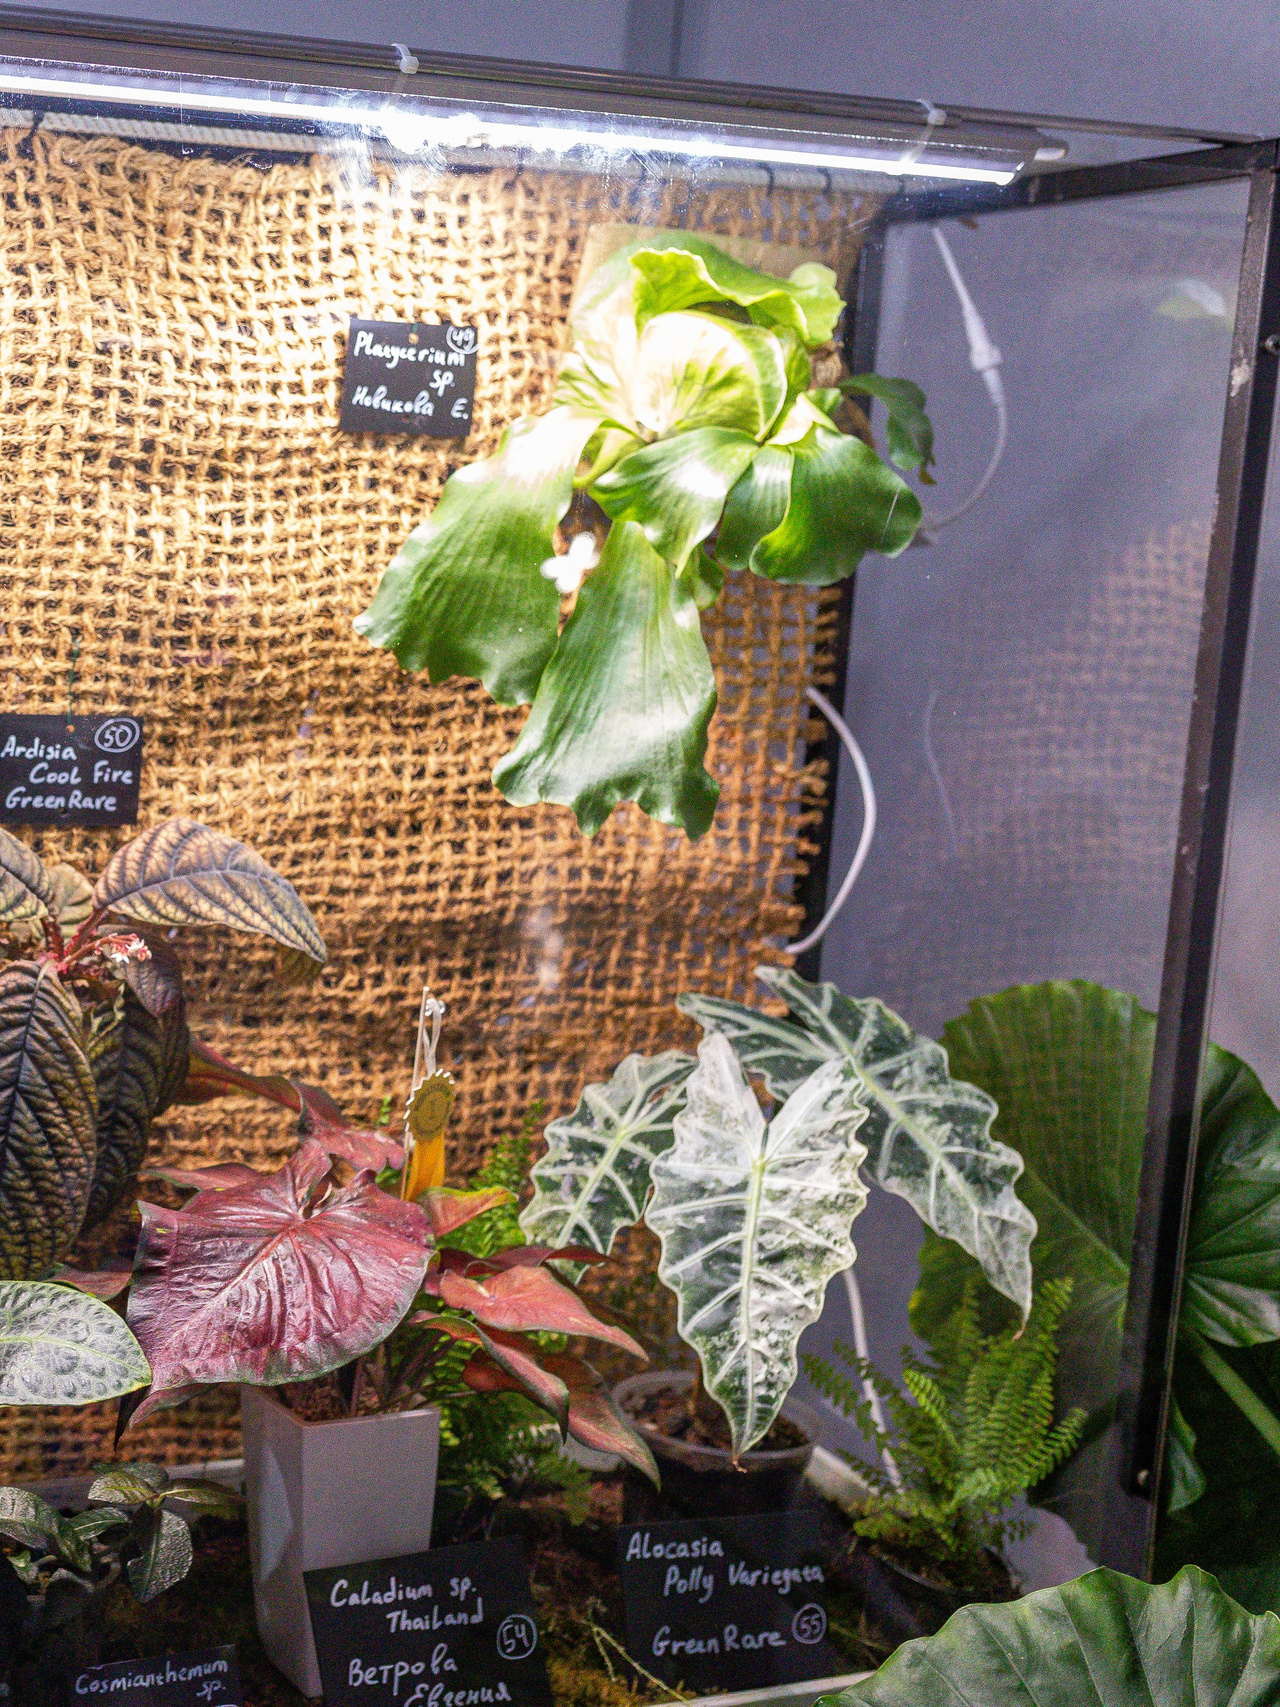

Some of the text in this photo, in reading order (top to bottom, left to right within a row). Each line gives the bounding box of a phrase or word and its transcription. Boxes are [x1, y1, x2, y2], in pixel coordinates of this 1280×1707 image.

[451, 327, 475, 352] 49
[351, 384, 435, 417] Новикова
[0, 734, 78, 761] Ardisia
[103, 724, 133, 748] 50
[93, 759, 134, 785] Fire
[5, 786, 117, 812] GreenRare
[625, 1531, 725, 1562] Alocasia
[330, 1576, 477, 1608] Caladium sp.
[663, 1564, 714, 1604] Polly
[386, 1597, 484, 1633] Thailand
[799, 1613, 822, 1638] 55
[502, 1619, 531, 1654] 54
[75, 1660, 229, 1695] Cosmianthemum
[348, 1642, 458, 1697] Ветрова
[196, 1679, 227, 1702] sp.
